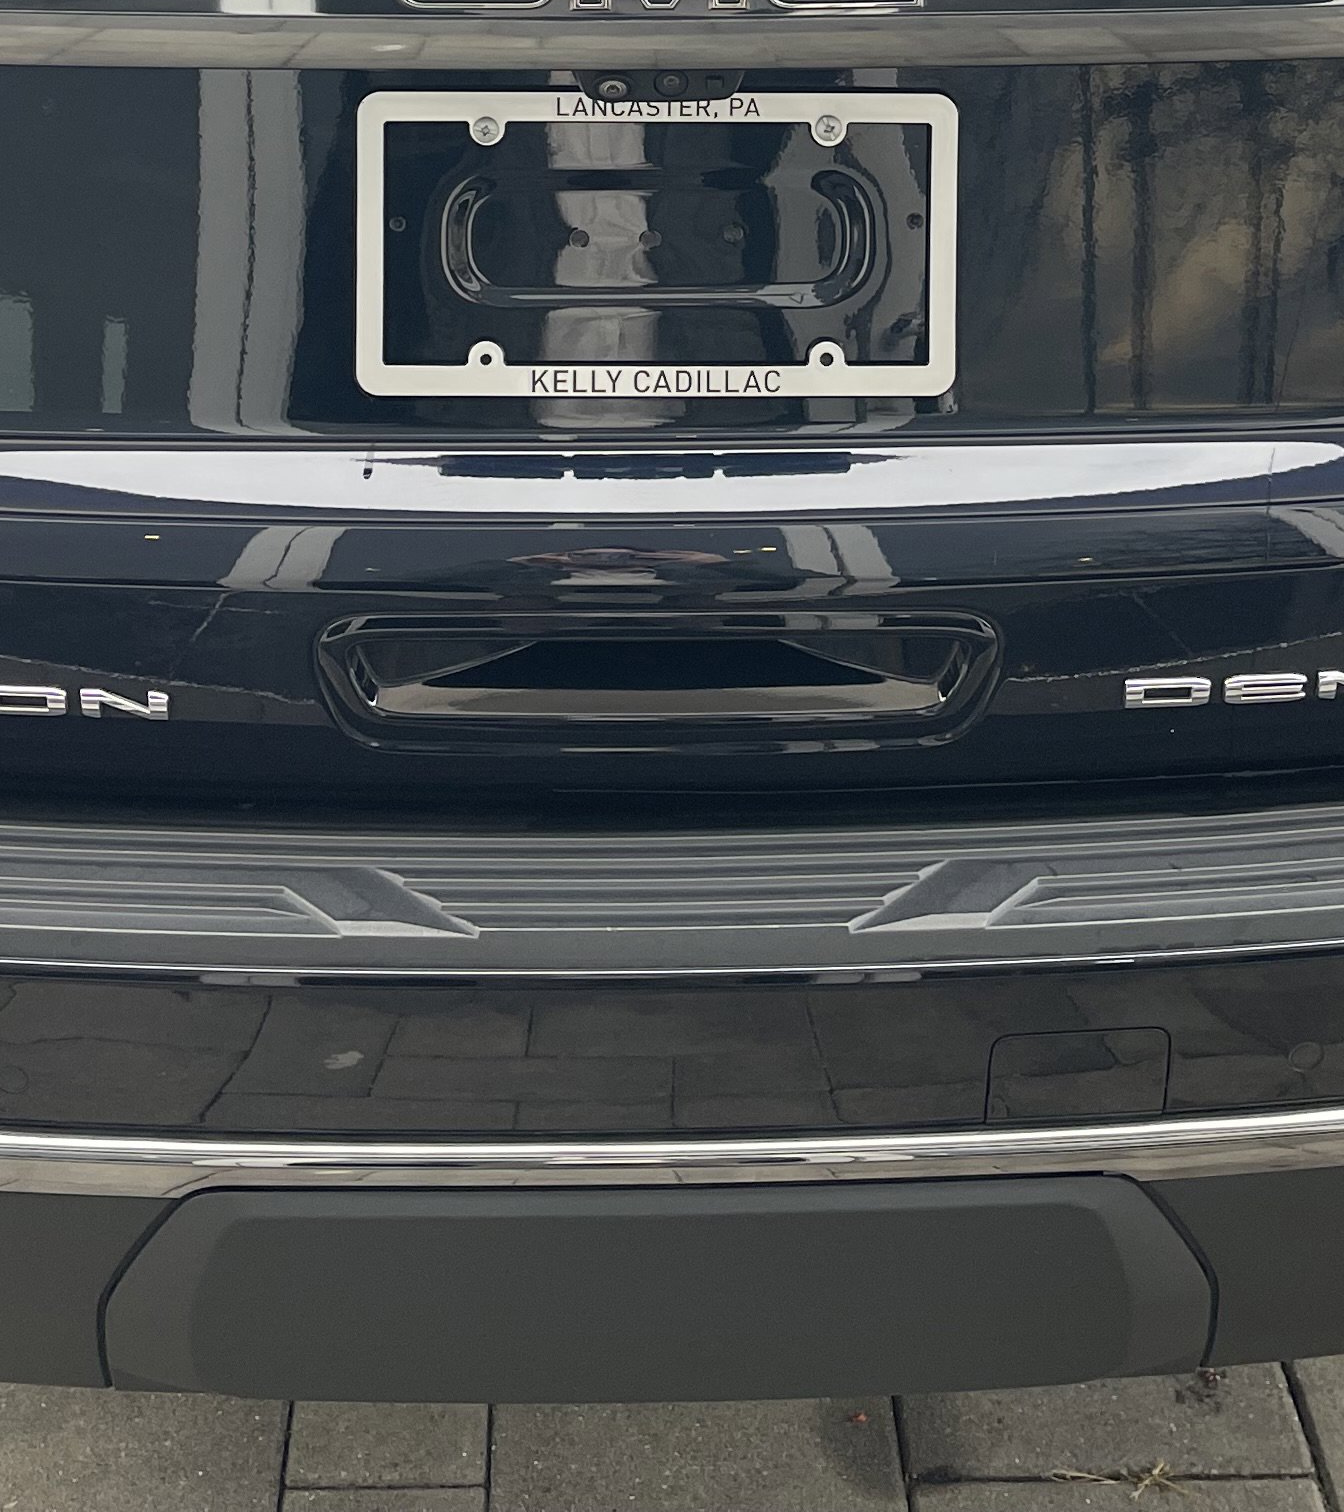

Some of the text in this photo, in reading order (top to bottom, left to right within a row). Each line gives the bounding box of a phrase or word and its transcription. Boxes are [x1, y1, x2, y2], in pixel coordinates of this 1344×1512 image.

[556, 97, 760, 119] LANCASTER, PA
[531, 370, 781, 393] KELLY CADILLAC
